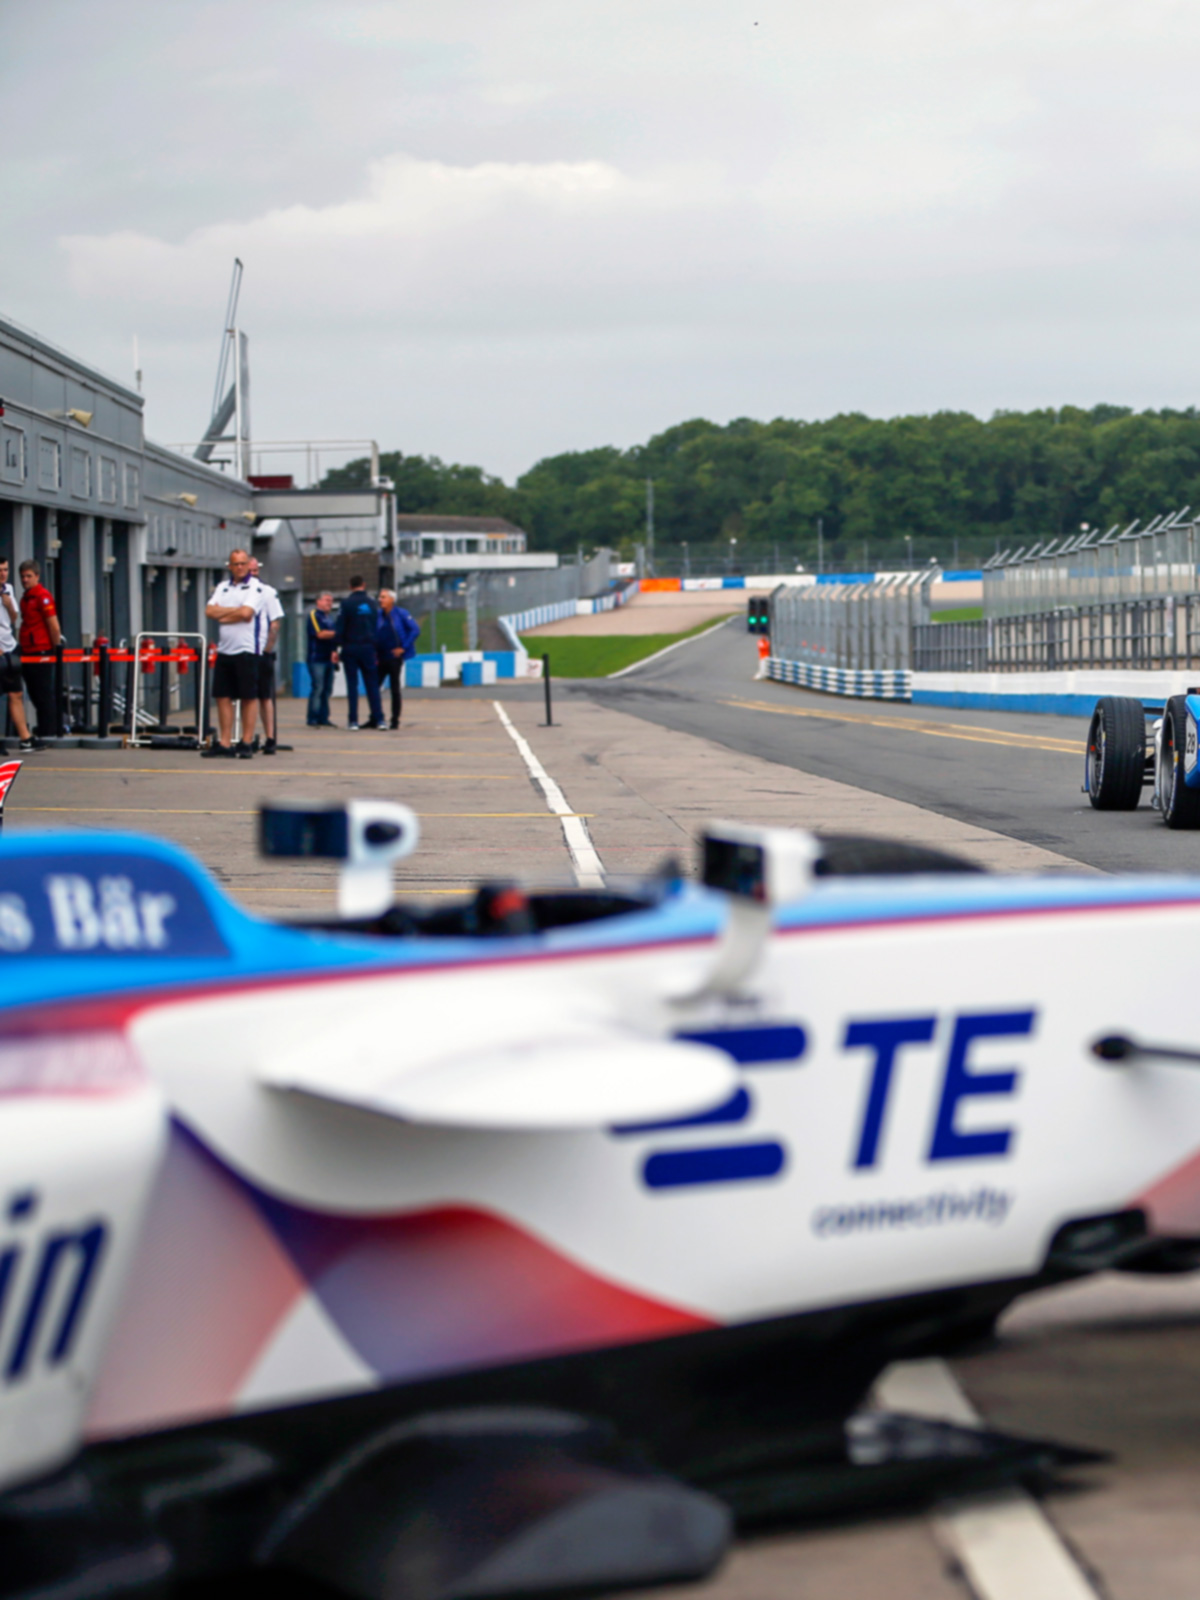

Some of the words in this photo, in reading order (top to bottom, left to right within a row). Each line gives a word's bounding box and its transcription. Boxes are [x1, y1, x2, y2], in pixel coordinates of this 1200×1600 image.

[47, 873, 177, 950] Bär
[836, 1002, 1038, 1177] TE
[812, 1184, 1016, 1239] connectivity
